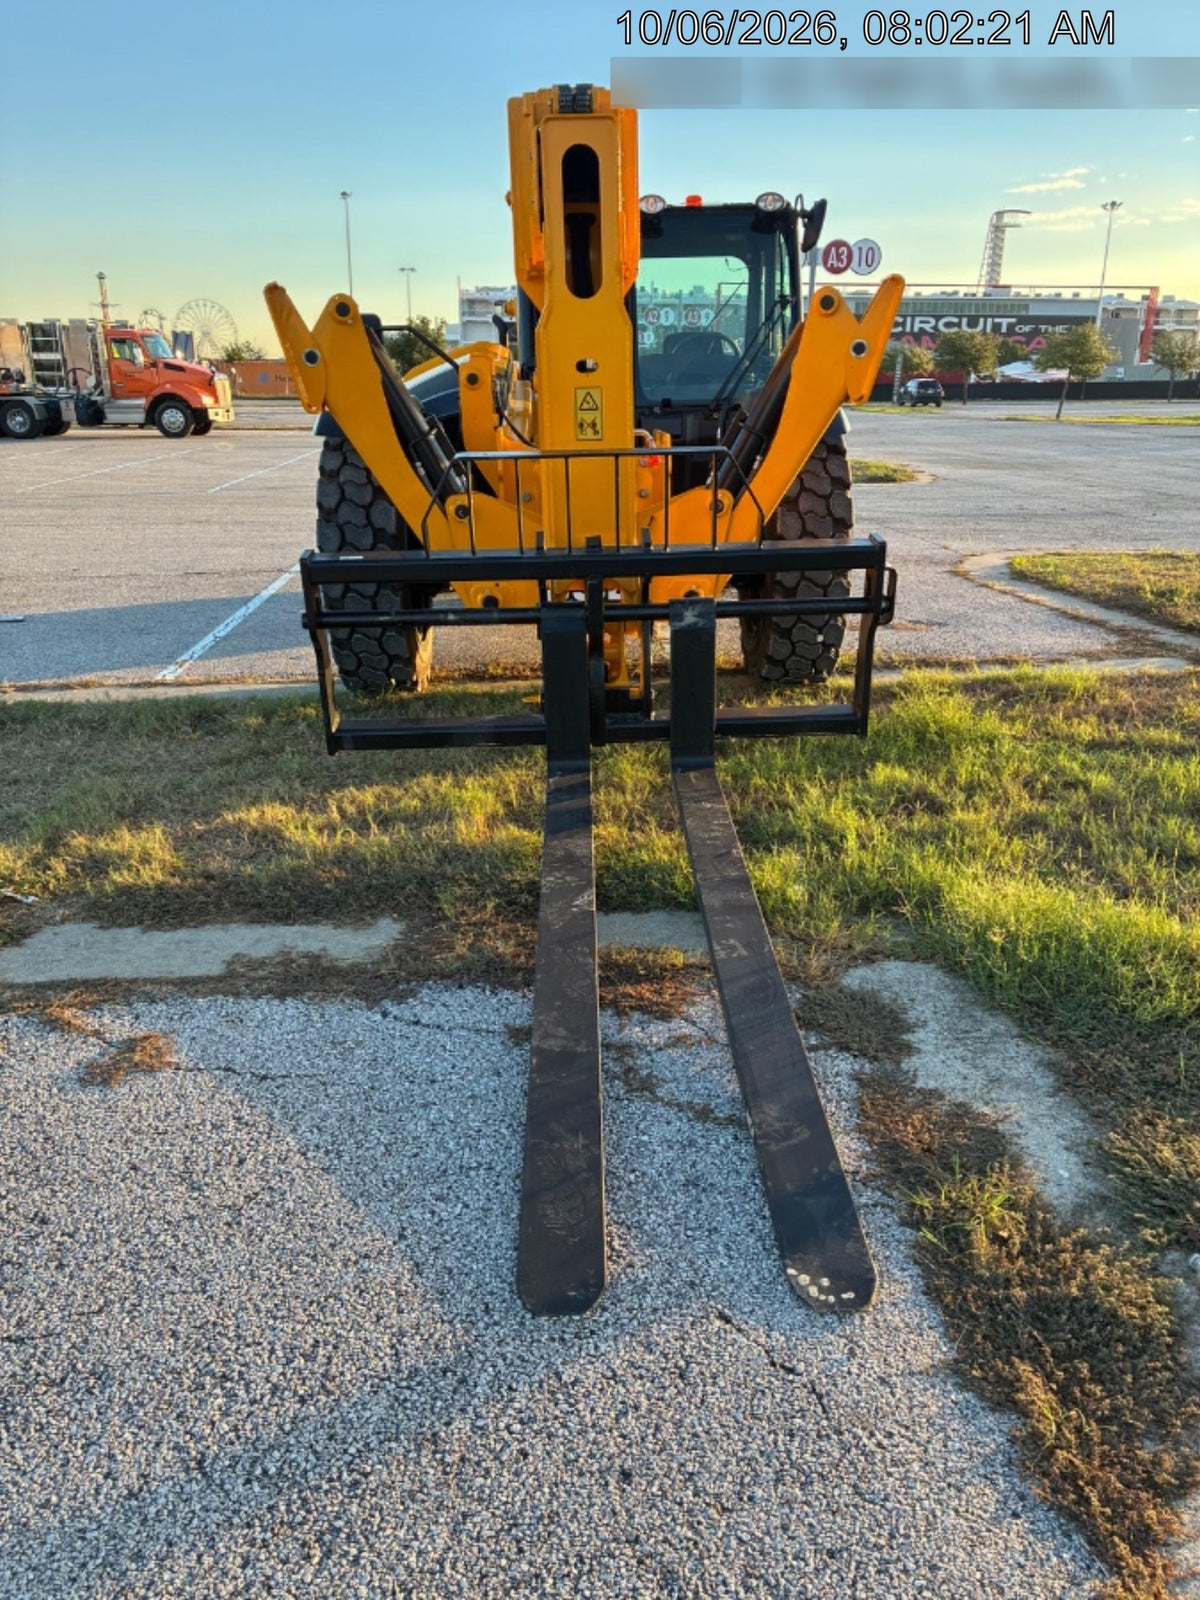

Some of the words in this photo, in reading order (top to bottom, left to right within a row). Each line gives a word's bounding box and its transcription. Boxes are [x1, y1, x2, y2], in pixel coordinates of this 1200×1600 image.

[827, 246, 848, 268] A3
[858, 246, 875, 268] 10
[891, 316, 1017, 334] CIRCUIT
[1015, 325, 1036, 334] OF
[1038, 324, 1068, 334] THE
